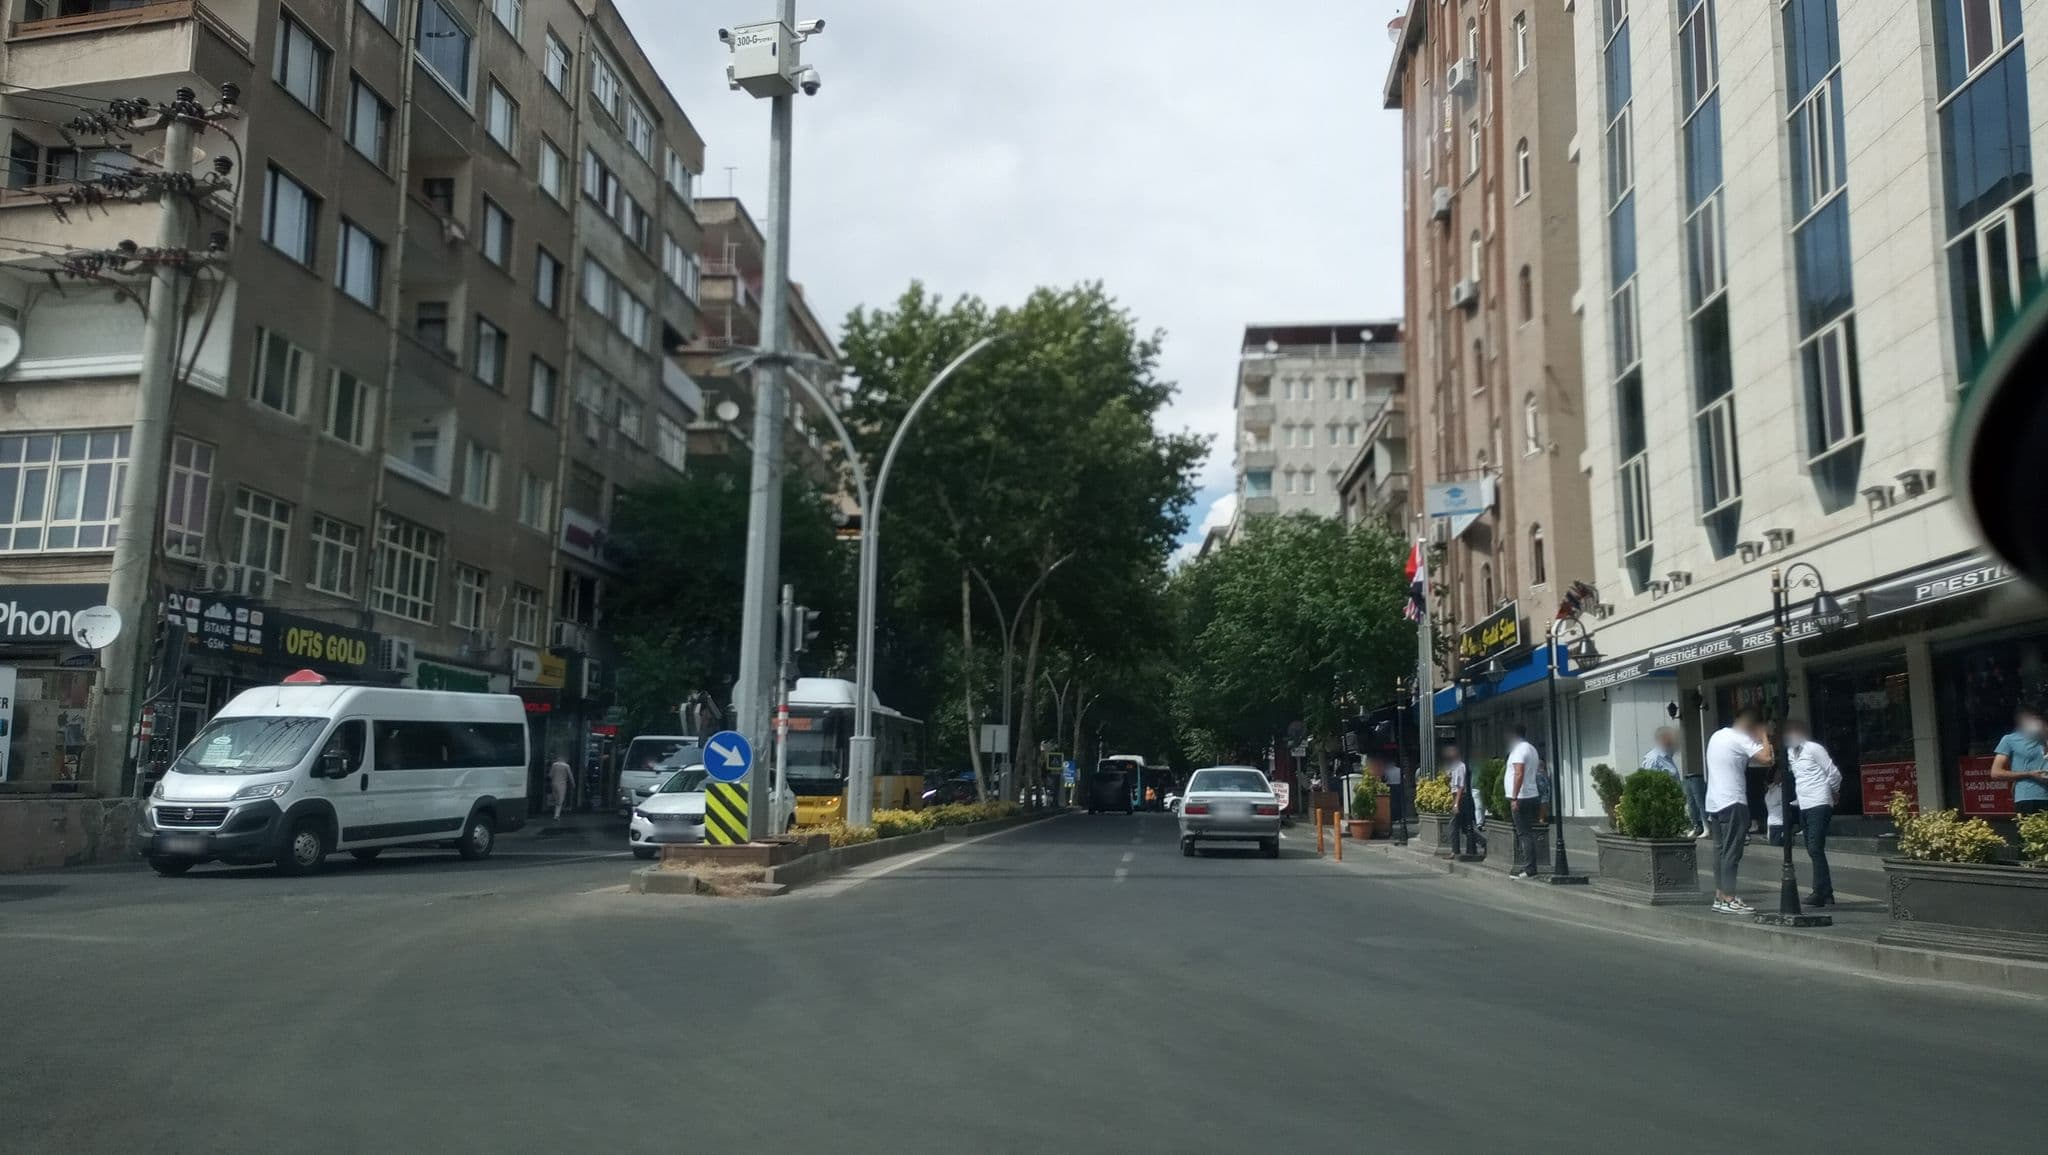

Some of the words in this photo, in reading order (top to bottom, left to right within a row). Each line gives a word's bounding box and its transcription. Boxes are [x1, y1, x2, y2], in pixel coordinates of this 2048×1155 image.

[326, 634, 366, 665] GOLD
[1654, 649, 1698, 668] PRESTIGE
[1699, 639, 1733, 656] HOTEL
[1584, 673, 1615, 690] PRESTIGE
[1616, 664, 1642, 681] HOTEL
